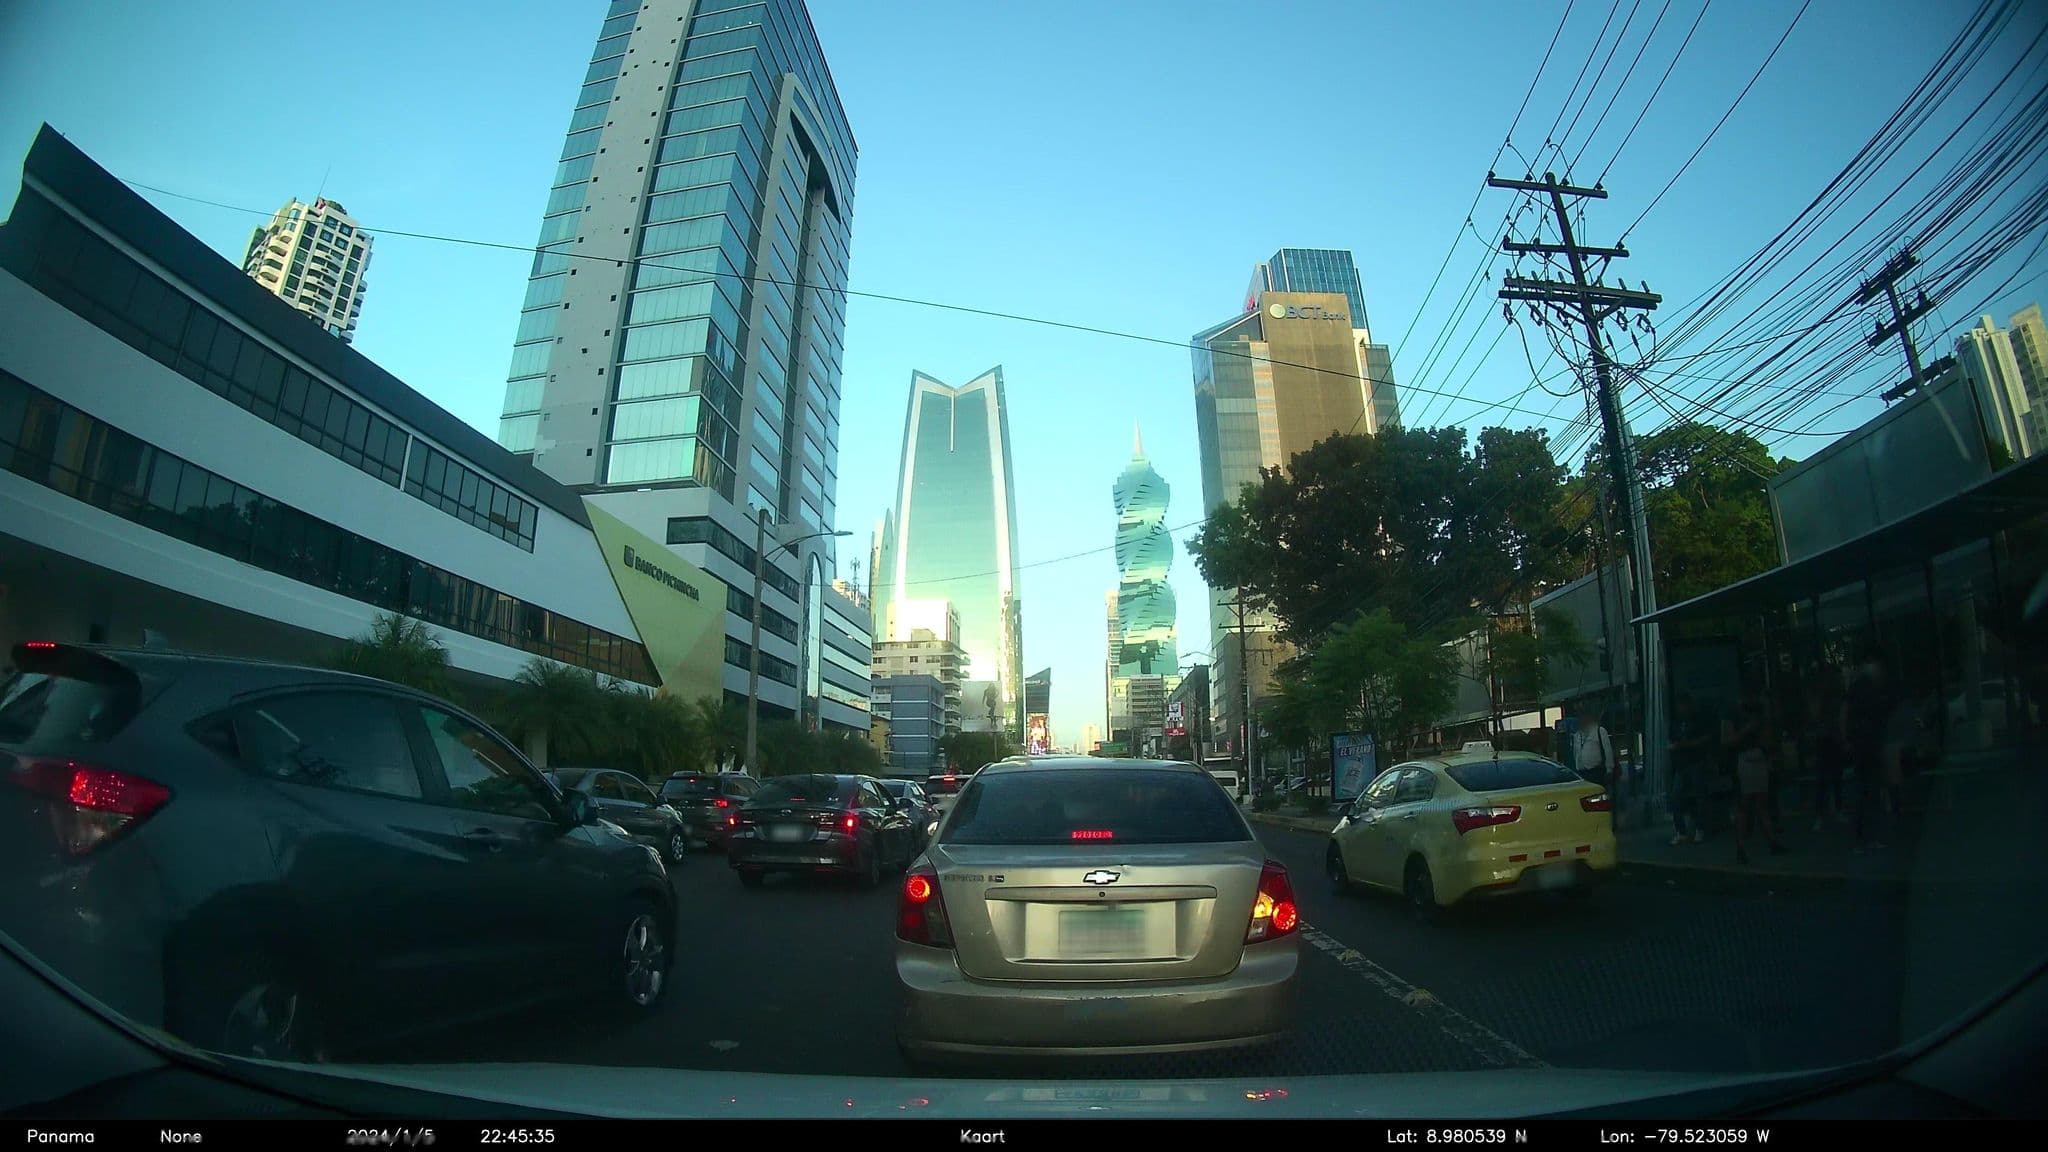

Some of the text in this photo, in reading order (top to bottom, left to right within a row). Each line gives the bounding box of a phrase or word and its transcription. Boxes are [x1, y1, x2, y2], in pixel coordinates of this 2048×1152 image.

[1287, 305, 1346, 321] BCT Bank
[635, 556, 662, 581] BANCO
